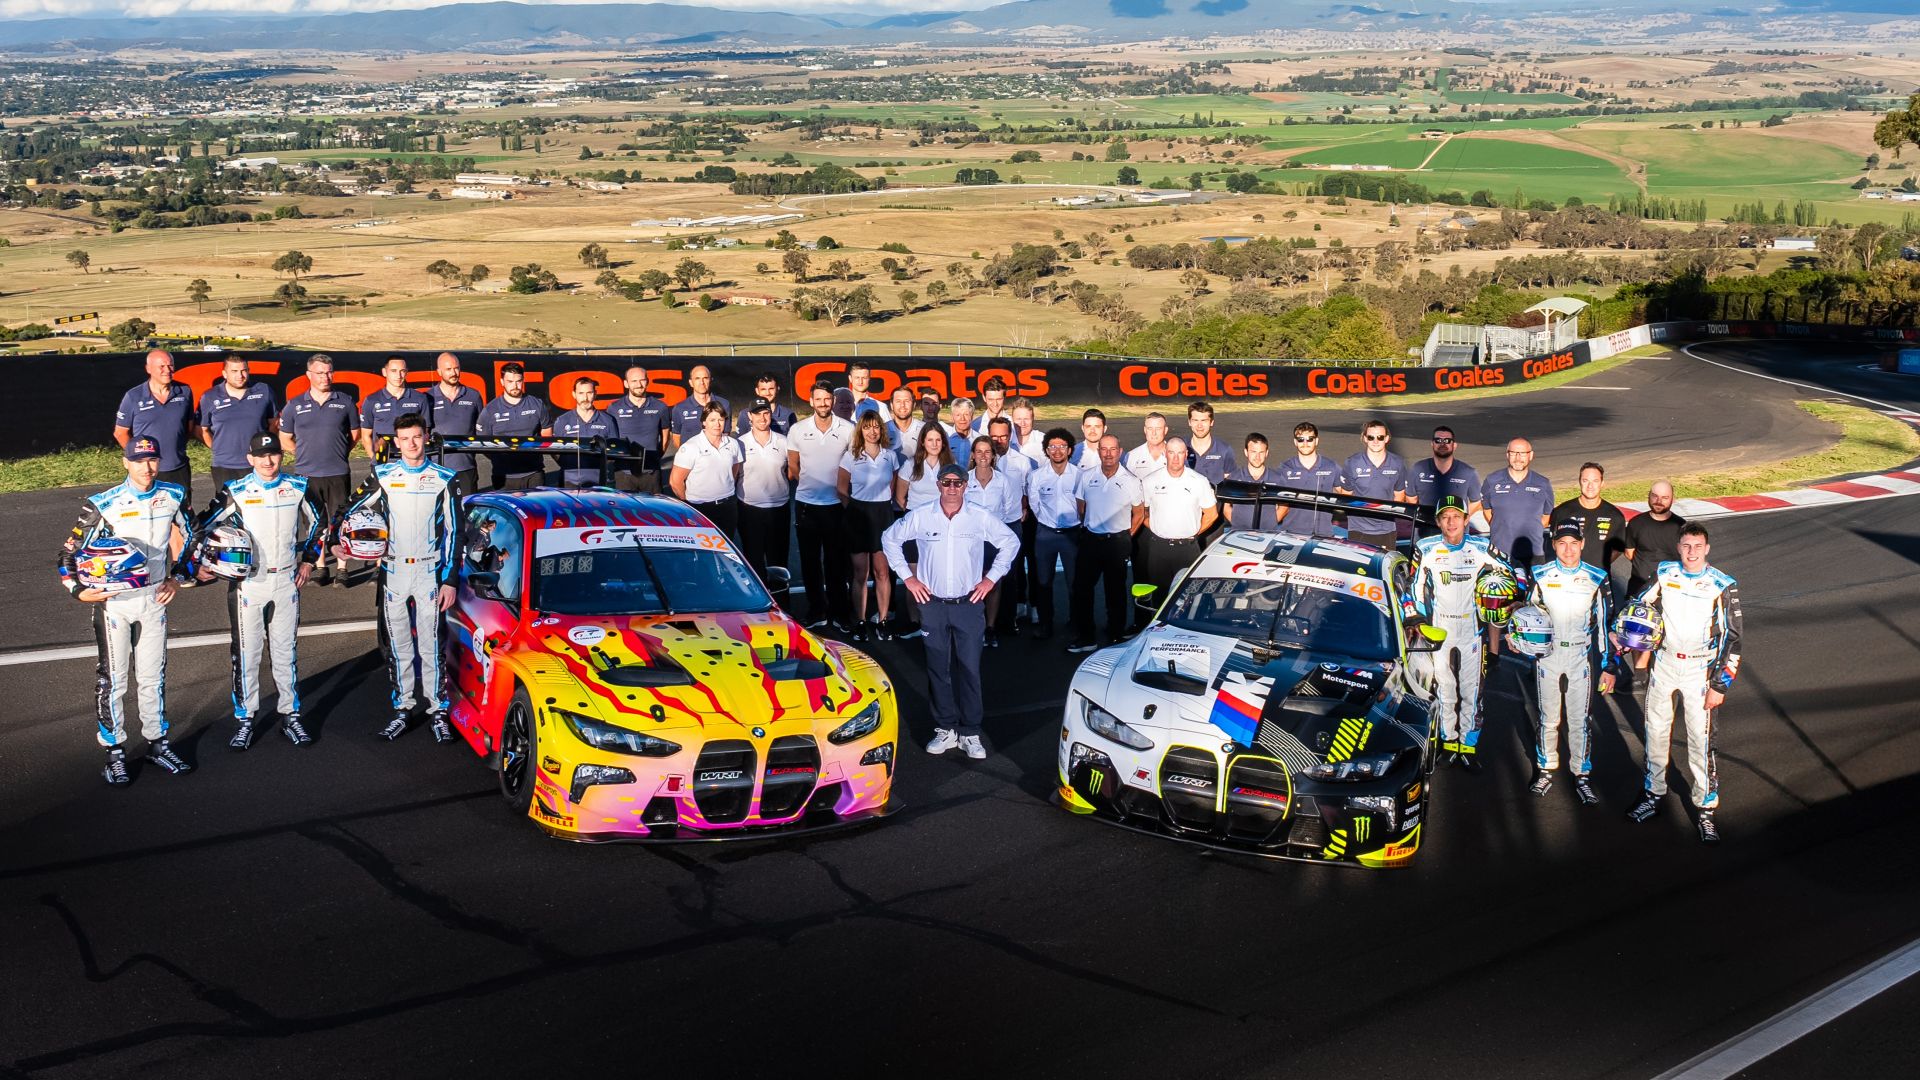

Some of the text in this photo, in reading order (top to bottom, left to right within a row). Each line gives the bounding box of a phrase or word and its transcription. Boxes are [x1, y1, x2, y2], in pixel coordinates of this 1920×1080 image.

[1708, 324, 1729, 334] TOYOTA
[1877, 329, 1905, 338] TOYOTA
[1522, 350, 1575, 379] Coates
[795, 361, 1050, 403] Coates
[1119, 365, 1268, 398] Coates
[1307, 367, 1407, 394] Coates
[1434, 367, 1505, 390] Coates
[652, 536, 697, 545] CHALLENGE
[696, 533, 730, 551] 32
[1293, 575, 1346, 588] CHALLENGE
[1350, 582, 1384, 602] 46
[1322, 673, 1369, 690] Motorsport
[700, 770, 743, 782] WRT
[1167, 774, 1213, 788] WRT
